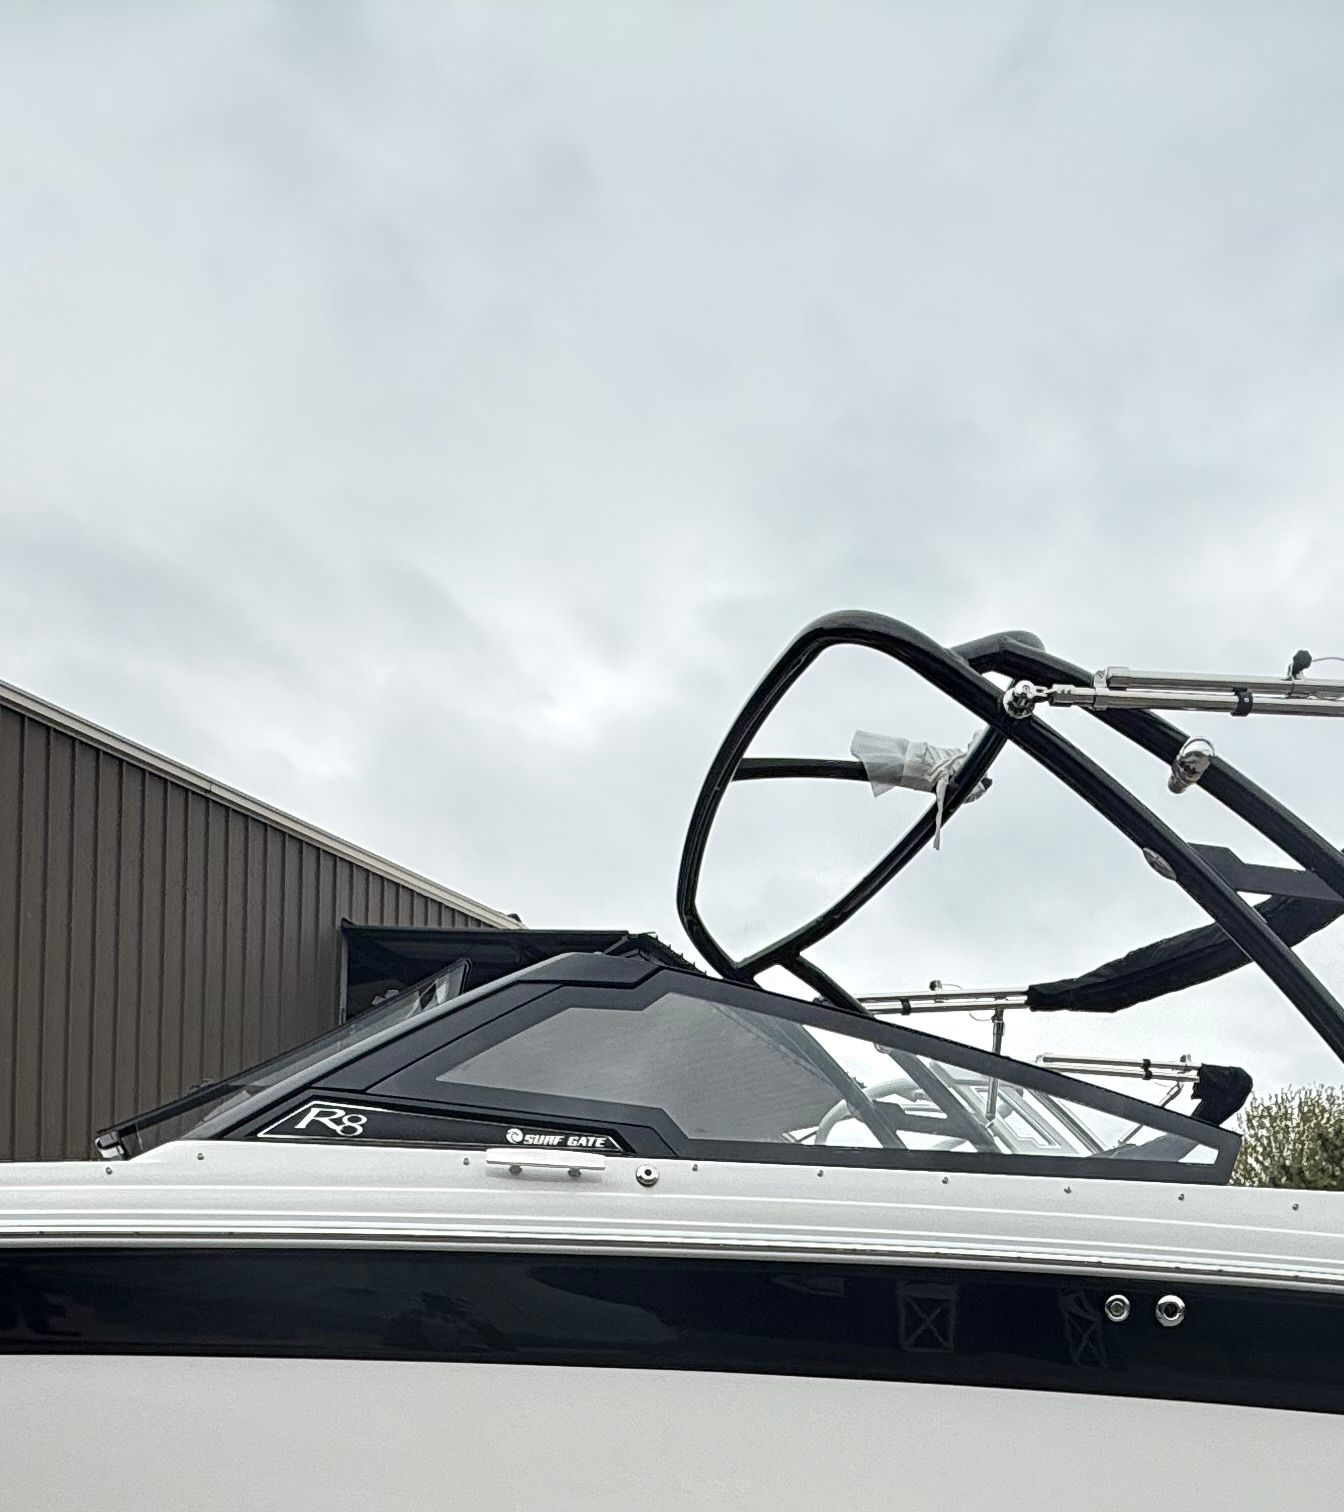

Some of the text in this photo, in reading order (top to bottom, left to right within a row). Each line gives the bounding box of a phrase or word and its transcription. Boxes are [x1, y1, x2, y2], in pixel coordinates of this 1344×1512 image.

[294, 1107, 368, 1137] R8
[523, 1134, 606, 1148] SURF GATE
